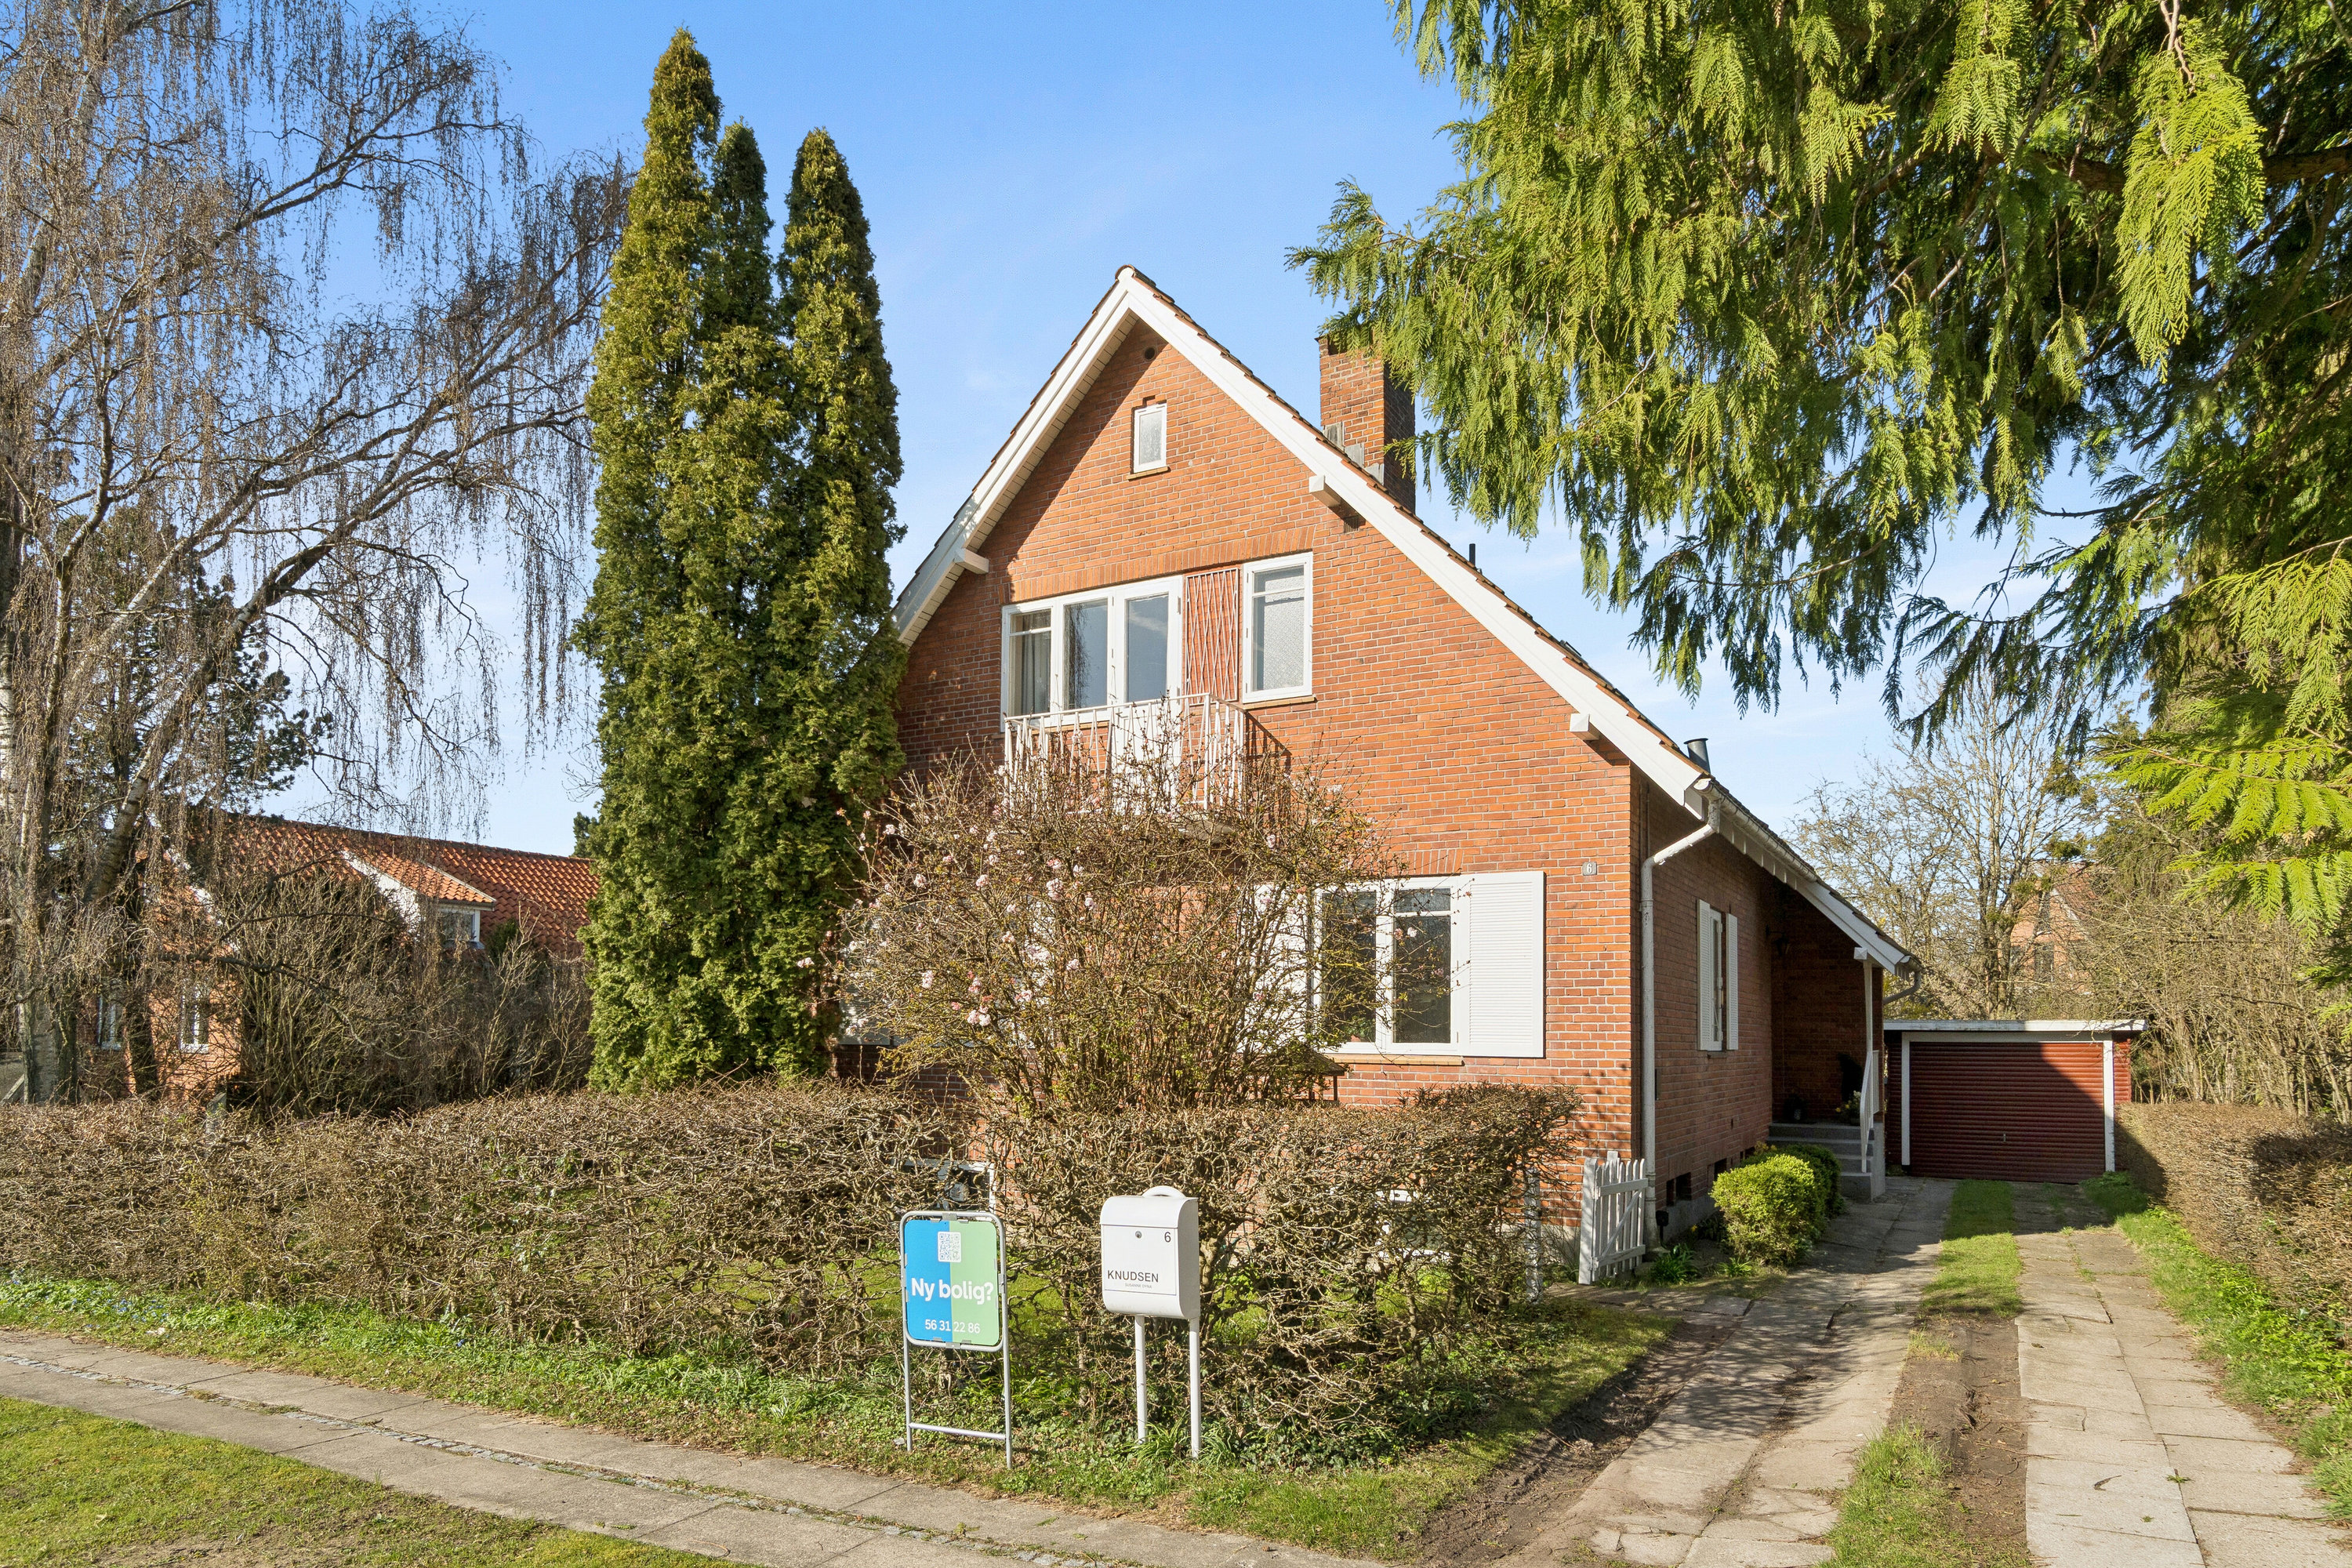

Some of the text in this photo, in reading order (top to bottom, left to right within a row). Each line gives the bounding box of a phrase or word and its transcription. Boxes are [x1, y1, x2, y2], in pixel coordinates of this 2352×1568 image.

[1587, 863, 1592, 873] 6
[1164, 1232, 1171, 1243] 6
[1108, 1270, 1159, 1283] KNUDSEN
[911, 1277, 994, 1305] Ny bolig?
[925, 1319, 980, 1334] 56 31 22 86
